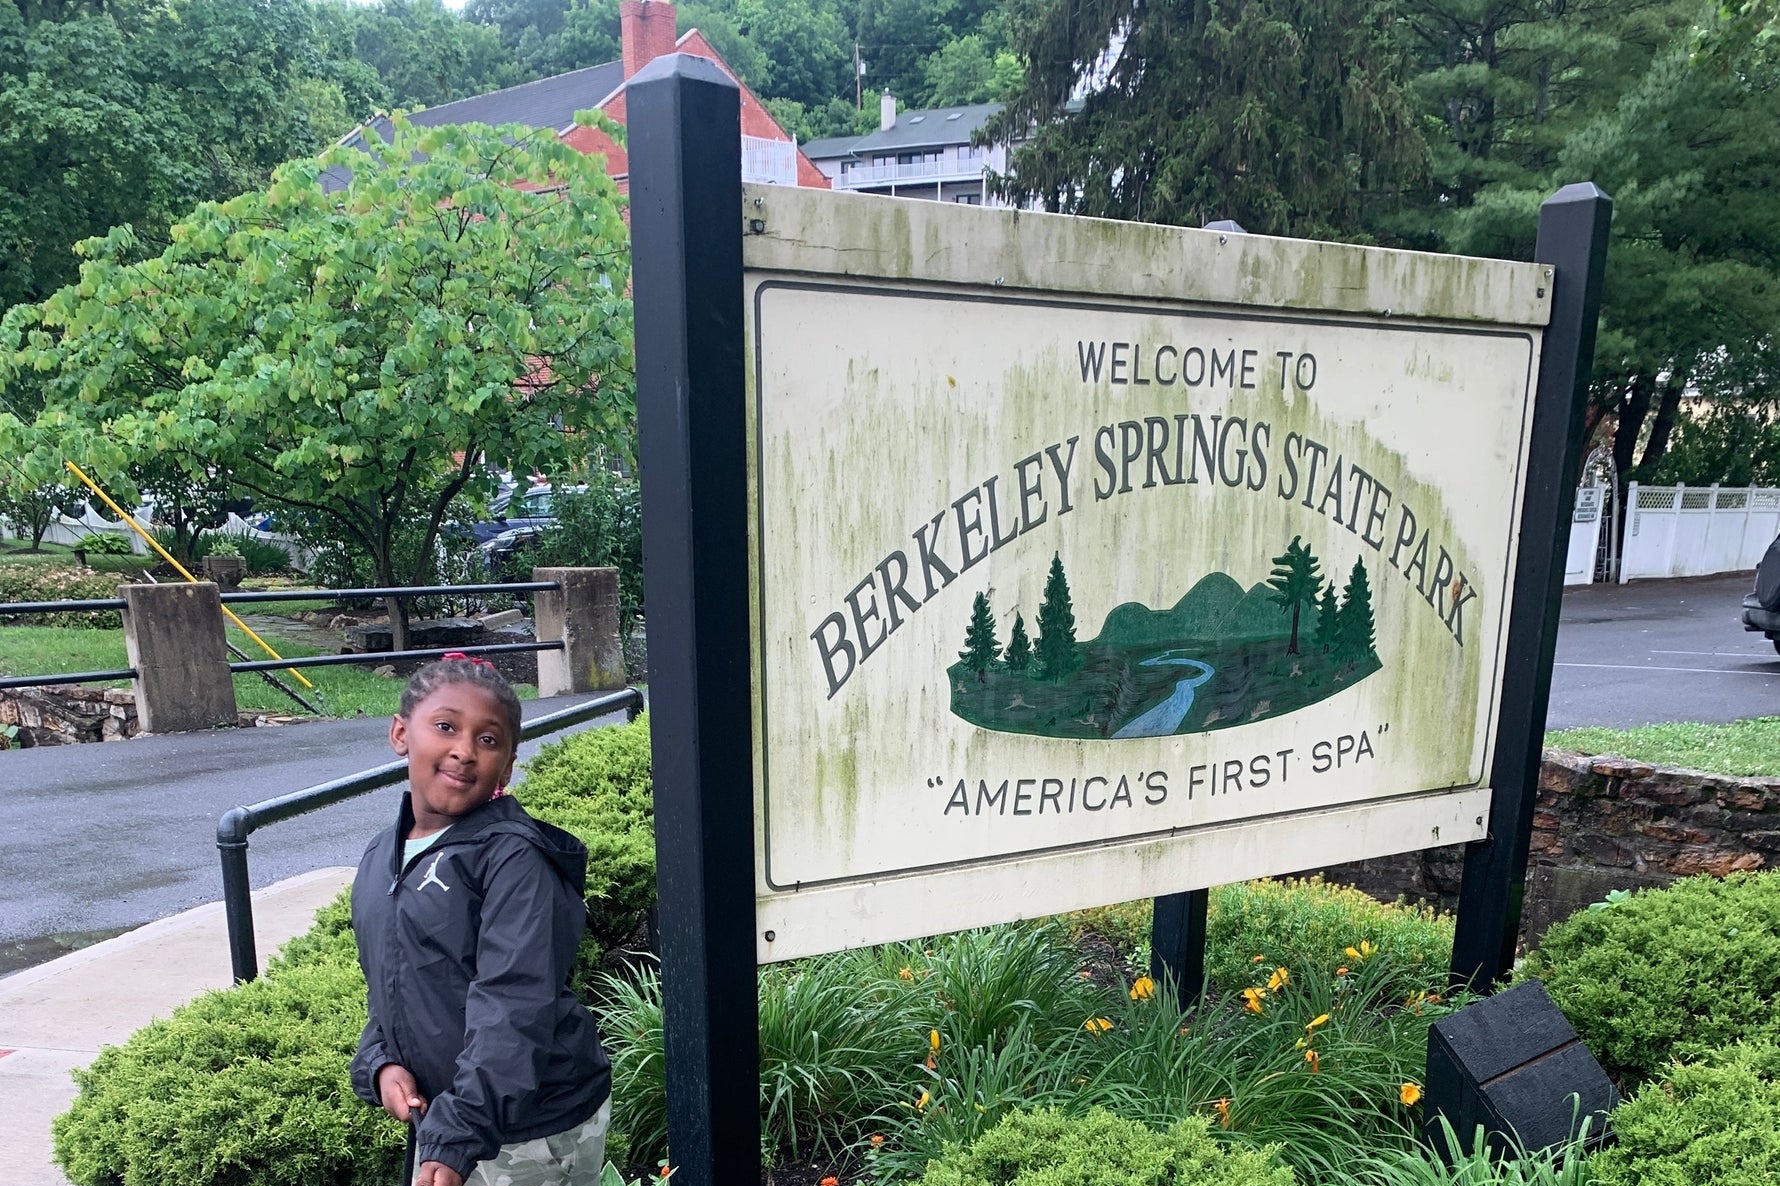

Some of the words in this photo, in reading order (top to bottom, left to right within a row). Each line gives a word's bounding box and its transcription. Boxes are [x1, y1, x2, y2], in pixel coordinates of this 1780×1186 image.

[1077, 340, 1258, 389] WELCOME
[1276, 351, 1317, 391] TO
[809, 435, 1080, 701] BERKELEY
[1093, 413, 1271, 501] SPRINGS
[1277, 431, 1393, 552] STATE
[1388, 503, 1478, 648] PARK
[1188, 748, 1295, 801] FIRST
